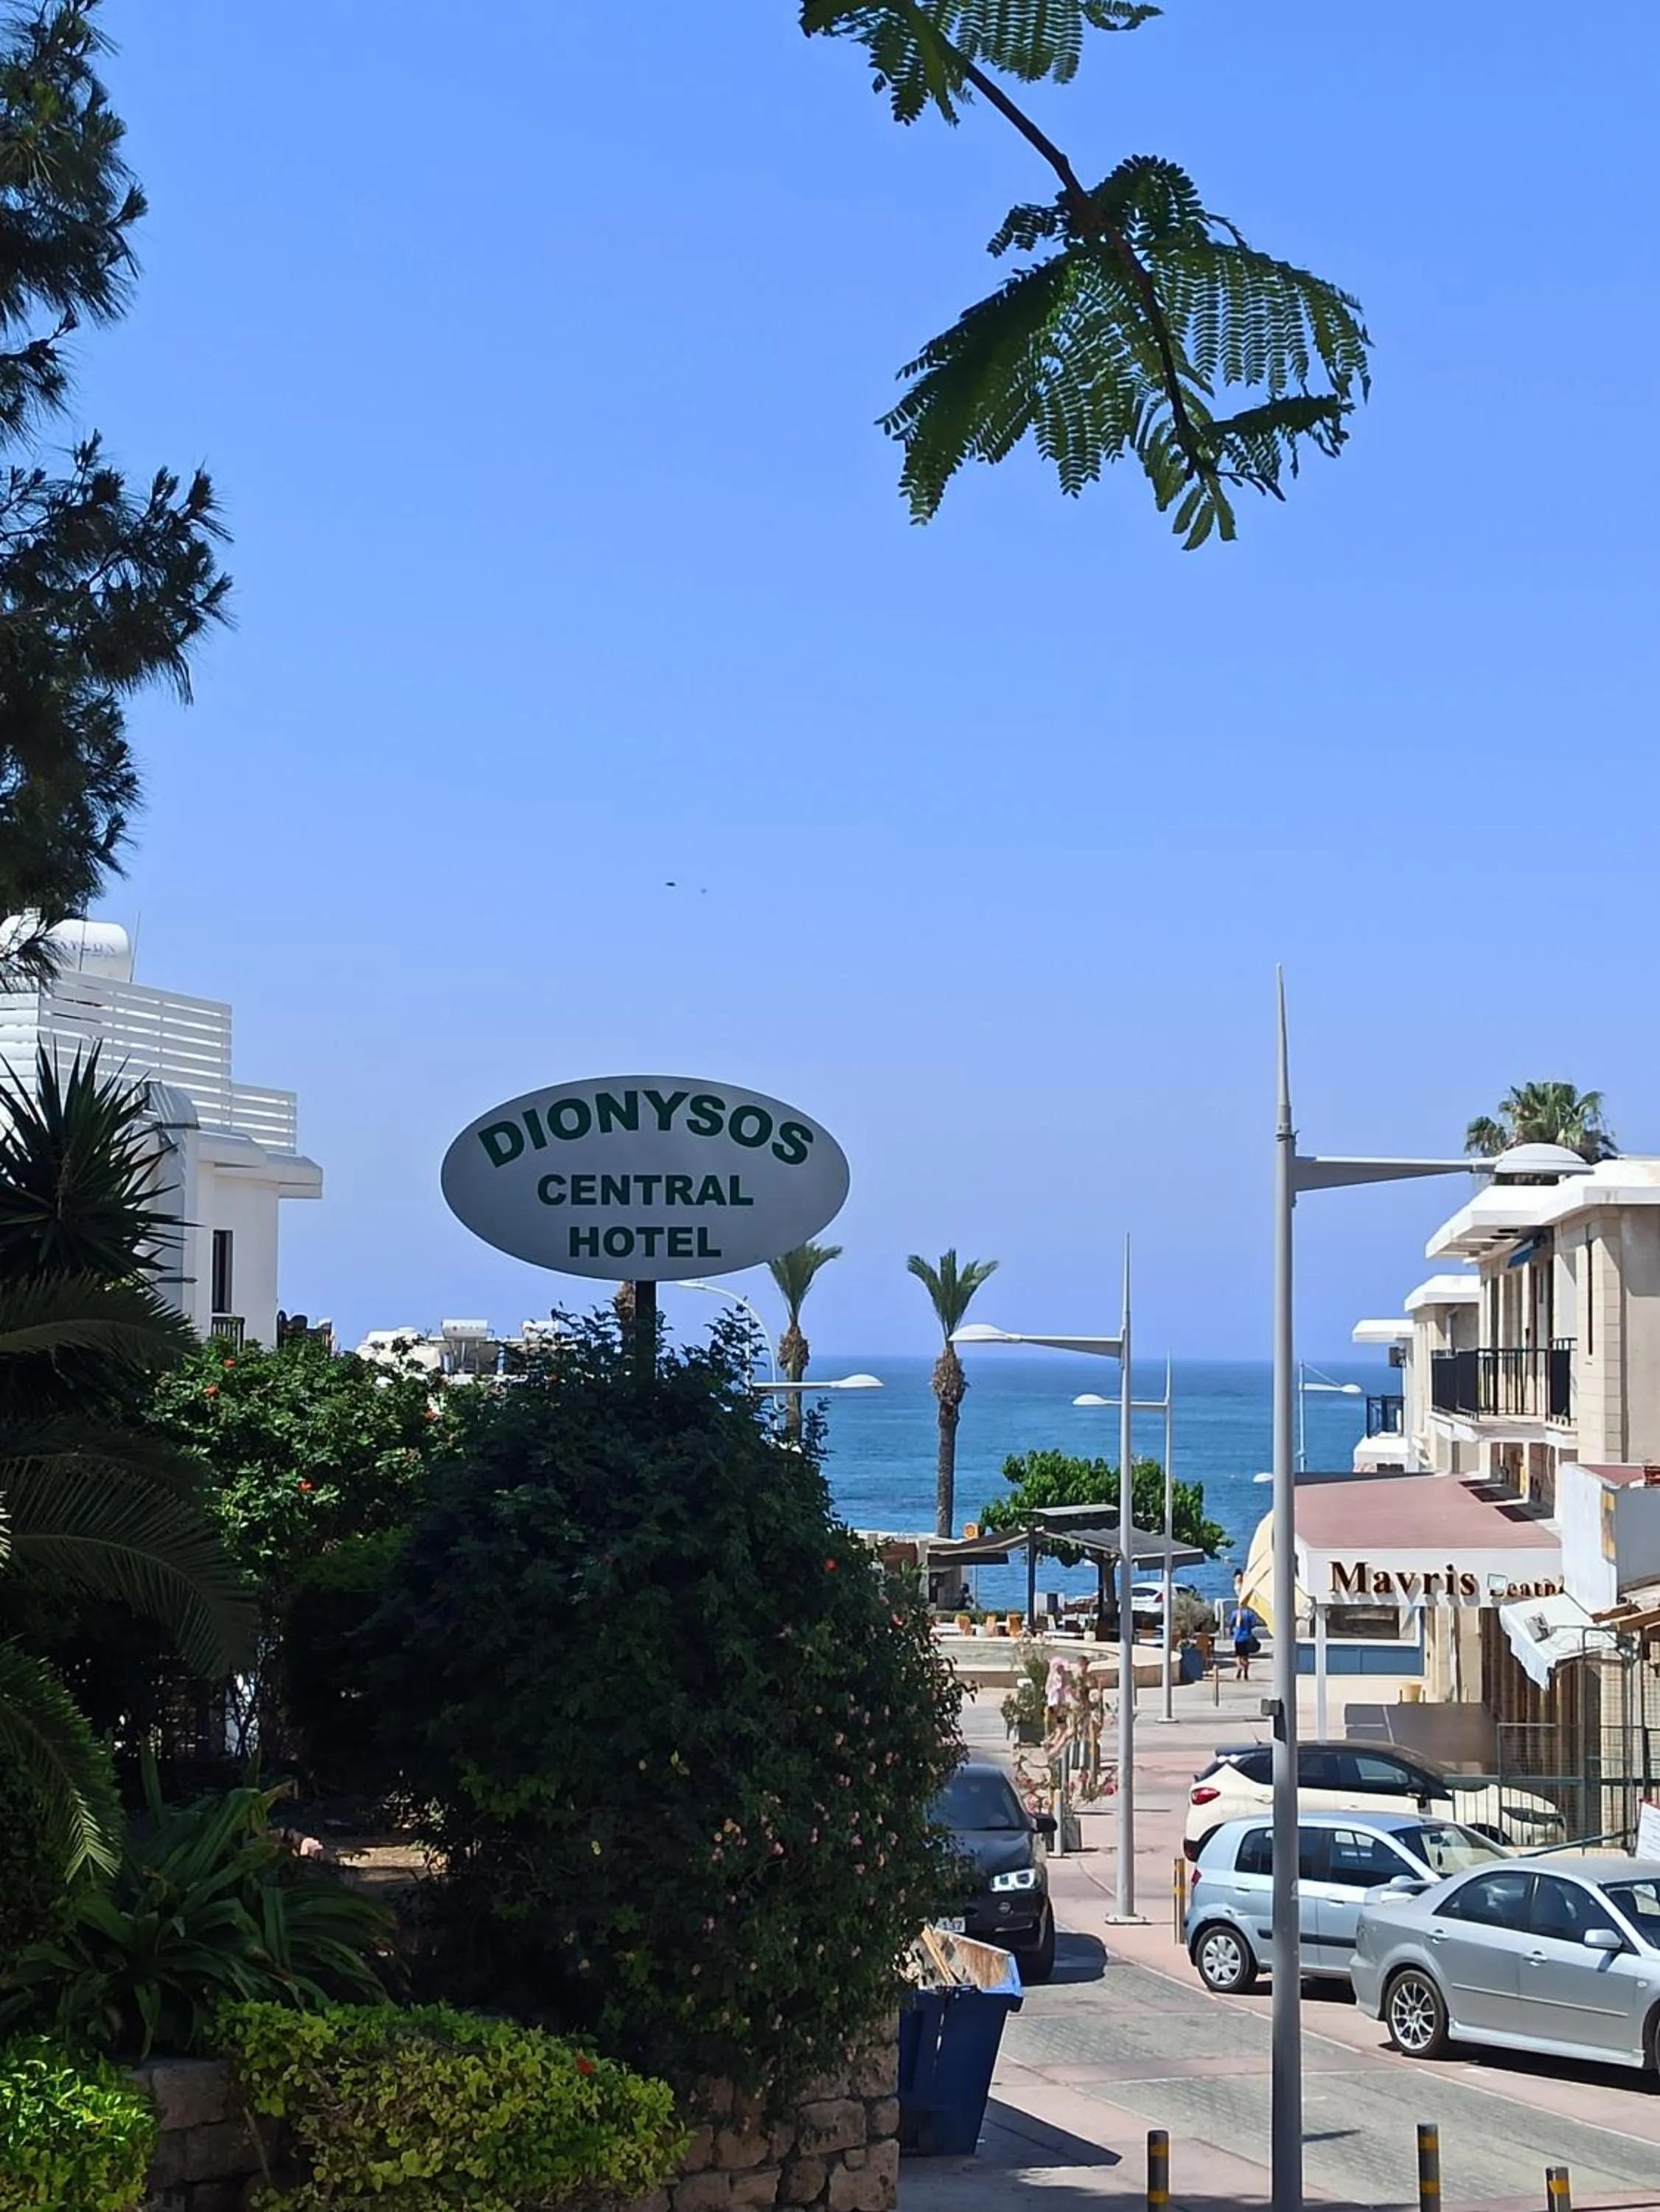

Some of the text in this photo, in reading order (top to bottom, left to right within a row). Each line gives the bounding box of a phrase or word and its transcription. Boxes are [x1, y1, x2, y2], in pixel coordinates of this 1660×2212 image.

[478, 1091, 814, 1167] DIONYSOS
[537, 1175, 753, 1206] CENTRAL
[569, 1227, 721, 1257] HOTEL
[1329, 1561, 1475, 1596] Mavris
